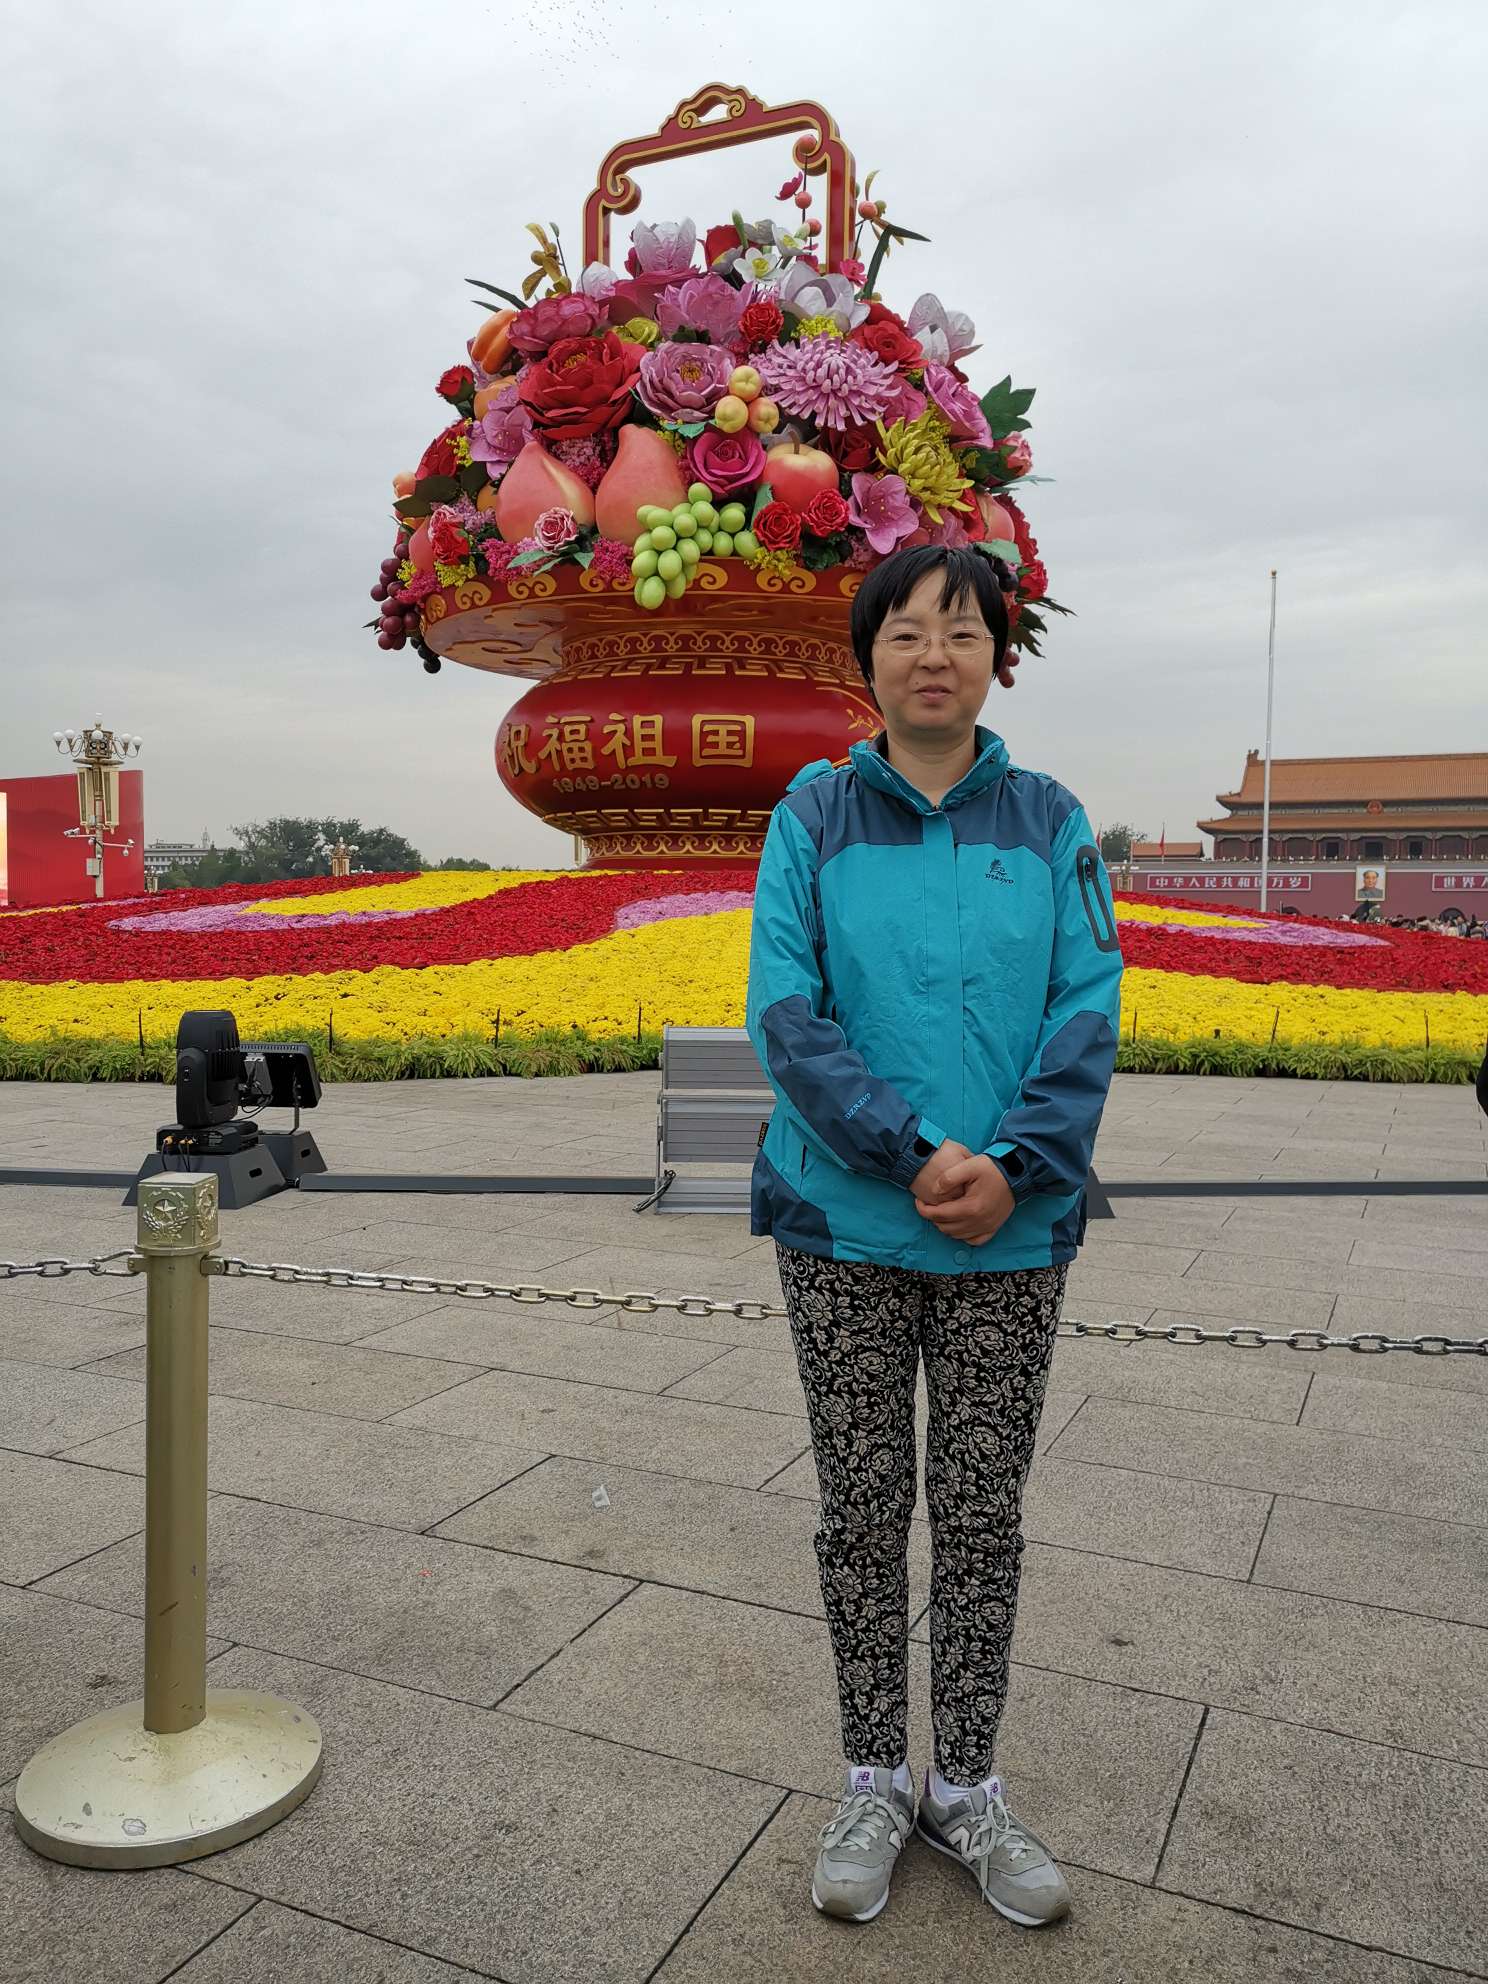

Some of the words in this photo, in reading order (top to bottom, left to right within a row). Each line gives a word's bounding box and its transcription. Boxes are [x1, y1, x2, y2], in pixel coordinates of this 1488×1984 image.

[502, 712, 756, 777] 祝福祖国
[552, 773, 670, 793] 1949-2019
